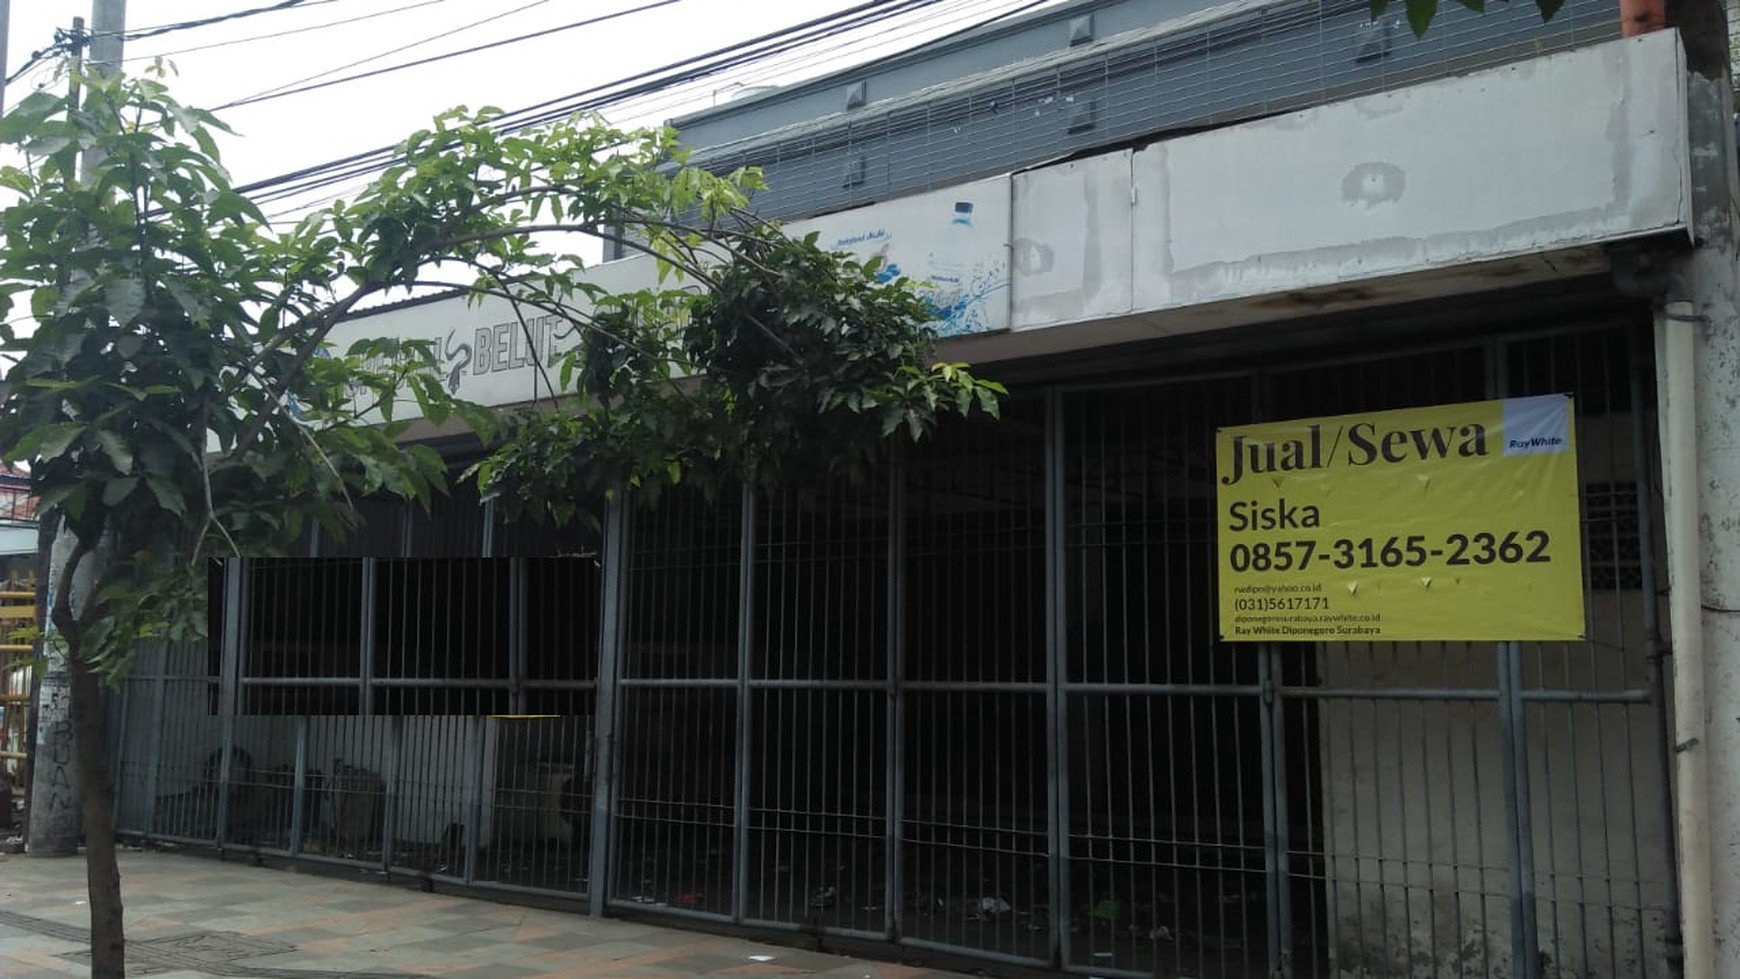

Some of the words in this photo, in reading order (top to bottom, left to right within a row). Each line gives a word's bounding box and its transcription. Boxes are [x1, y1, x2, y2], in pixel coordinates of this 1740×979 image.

[1509, 436, 1562, 449] RayWhite
[1221, 423, 1488, 486] Jual/Sewa
[1228, 499, 1320, 531] Siska
[1230, 530, 1550, 573] 0857-3165-2362
[1235, 597, 1329, 612] (031)5617171
[1235, 627, 1251, 636] Ray
[1252, 626, 1281, 635] White
[1282, 626, 1335, 637] Diponegoro
[1336, 625, 1381, 636] Surabaya
